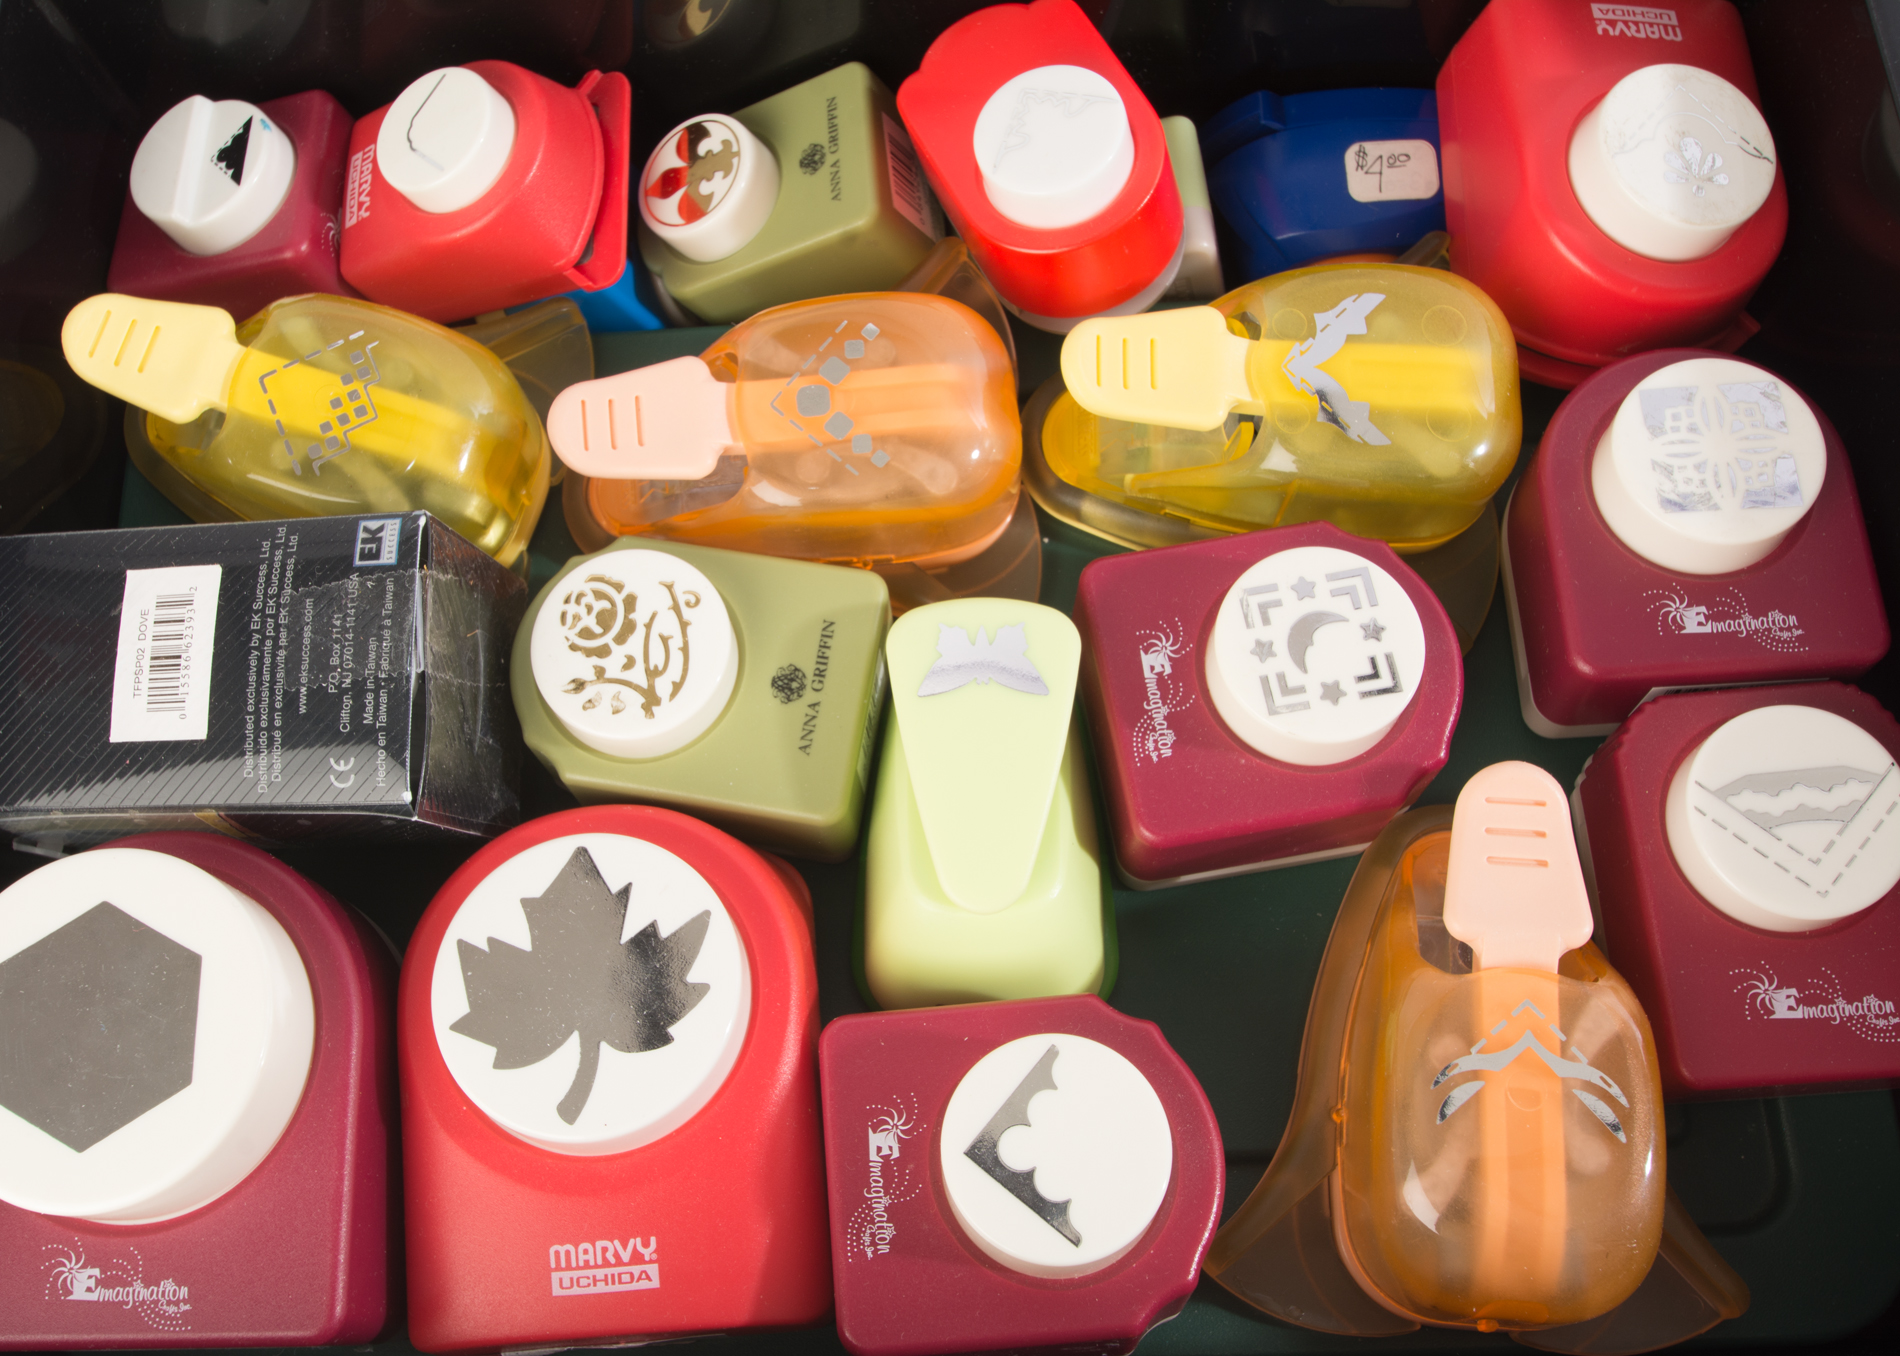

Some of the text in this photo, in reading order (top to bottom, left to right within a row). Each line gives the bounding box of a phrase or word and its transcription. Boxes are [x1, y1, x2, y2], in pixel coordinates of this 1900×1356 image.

[1596, 6, 1674, 23] UCHIDA
[1596, 20, 1682, 41] MARVY
[359, 143, 375, 219] MARVY
[826, 96, 841, 202] ANNA GRIFFIN
[347, 155, 362, 225] UCHIDA
[358, 522, 386, 562] EK
[386, 522, 397, 560] SUCCESS
[133, 608, 150, 699] TFPSP02 DOVE
[244, 538, 271, 777] Distributed exclusively by EK Success, Ltd.
[258, 524, 288, 792] Distribuido exclusivamente por EK Success, Ltd.
[271, 532, 299, 782] Distribué en exclusivité par EK Success, Ltd.
[299, 598, 314, 714] www.eksuccess.com
[330, 643, 340, 665] Box
[334, 614, 343, 638] 1141
[340, 572, 359, 732] Clifton, NJ 07014-1141 USA
[363, 637, 377, 724] Made in Taiwan
[376, 578, 394, 787] Hecho en Taiwan Fabriqué à Taiwan
[798, 619, 836, 756] ANNA GRIFFIN
[549, 1236, 657, 1268] MARVY
[558, 1270, 653, 1290] UCHIDA
